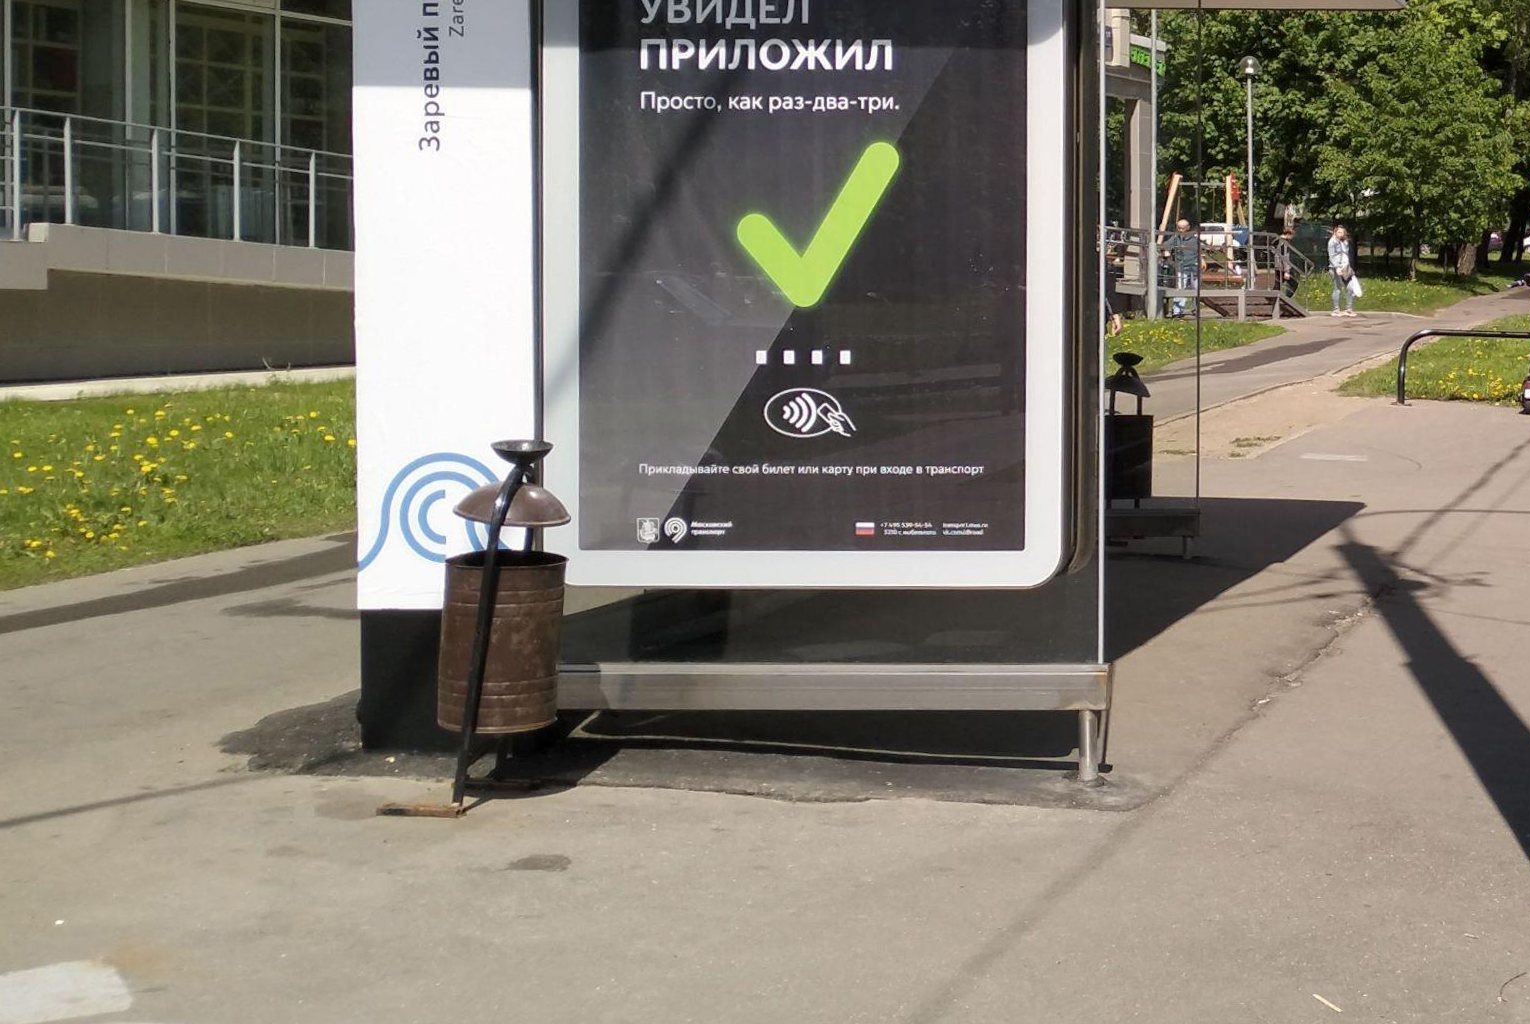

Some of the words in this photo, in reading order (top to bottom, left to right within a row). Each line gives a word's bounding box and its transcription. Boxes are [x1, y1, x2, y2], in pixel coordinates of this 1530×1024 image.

[640, 38, 893, 71] ПРИЛОЖИЛ
[416, 26, 445, 152] Заревый
[640, 91, 722, 114] Просто,
[728, 96, 764, 111] как
[768, 95, 901, 115] раз-два-три.
[639, 463, 730, 476] Прикладывайте
[731, 463, 760, 475] свой
[761, 463, 796, 475] билет
[797, 465, 819, 474] или
[821, 465, 854, 476] карту
[855, 465, 878, 477] при
[879, 465, 914, 476] входе
[915, 465, 923, 475] в
[925, 465, 985, 477] транспорт
